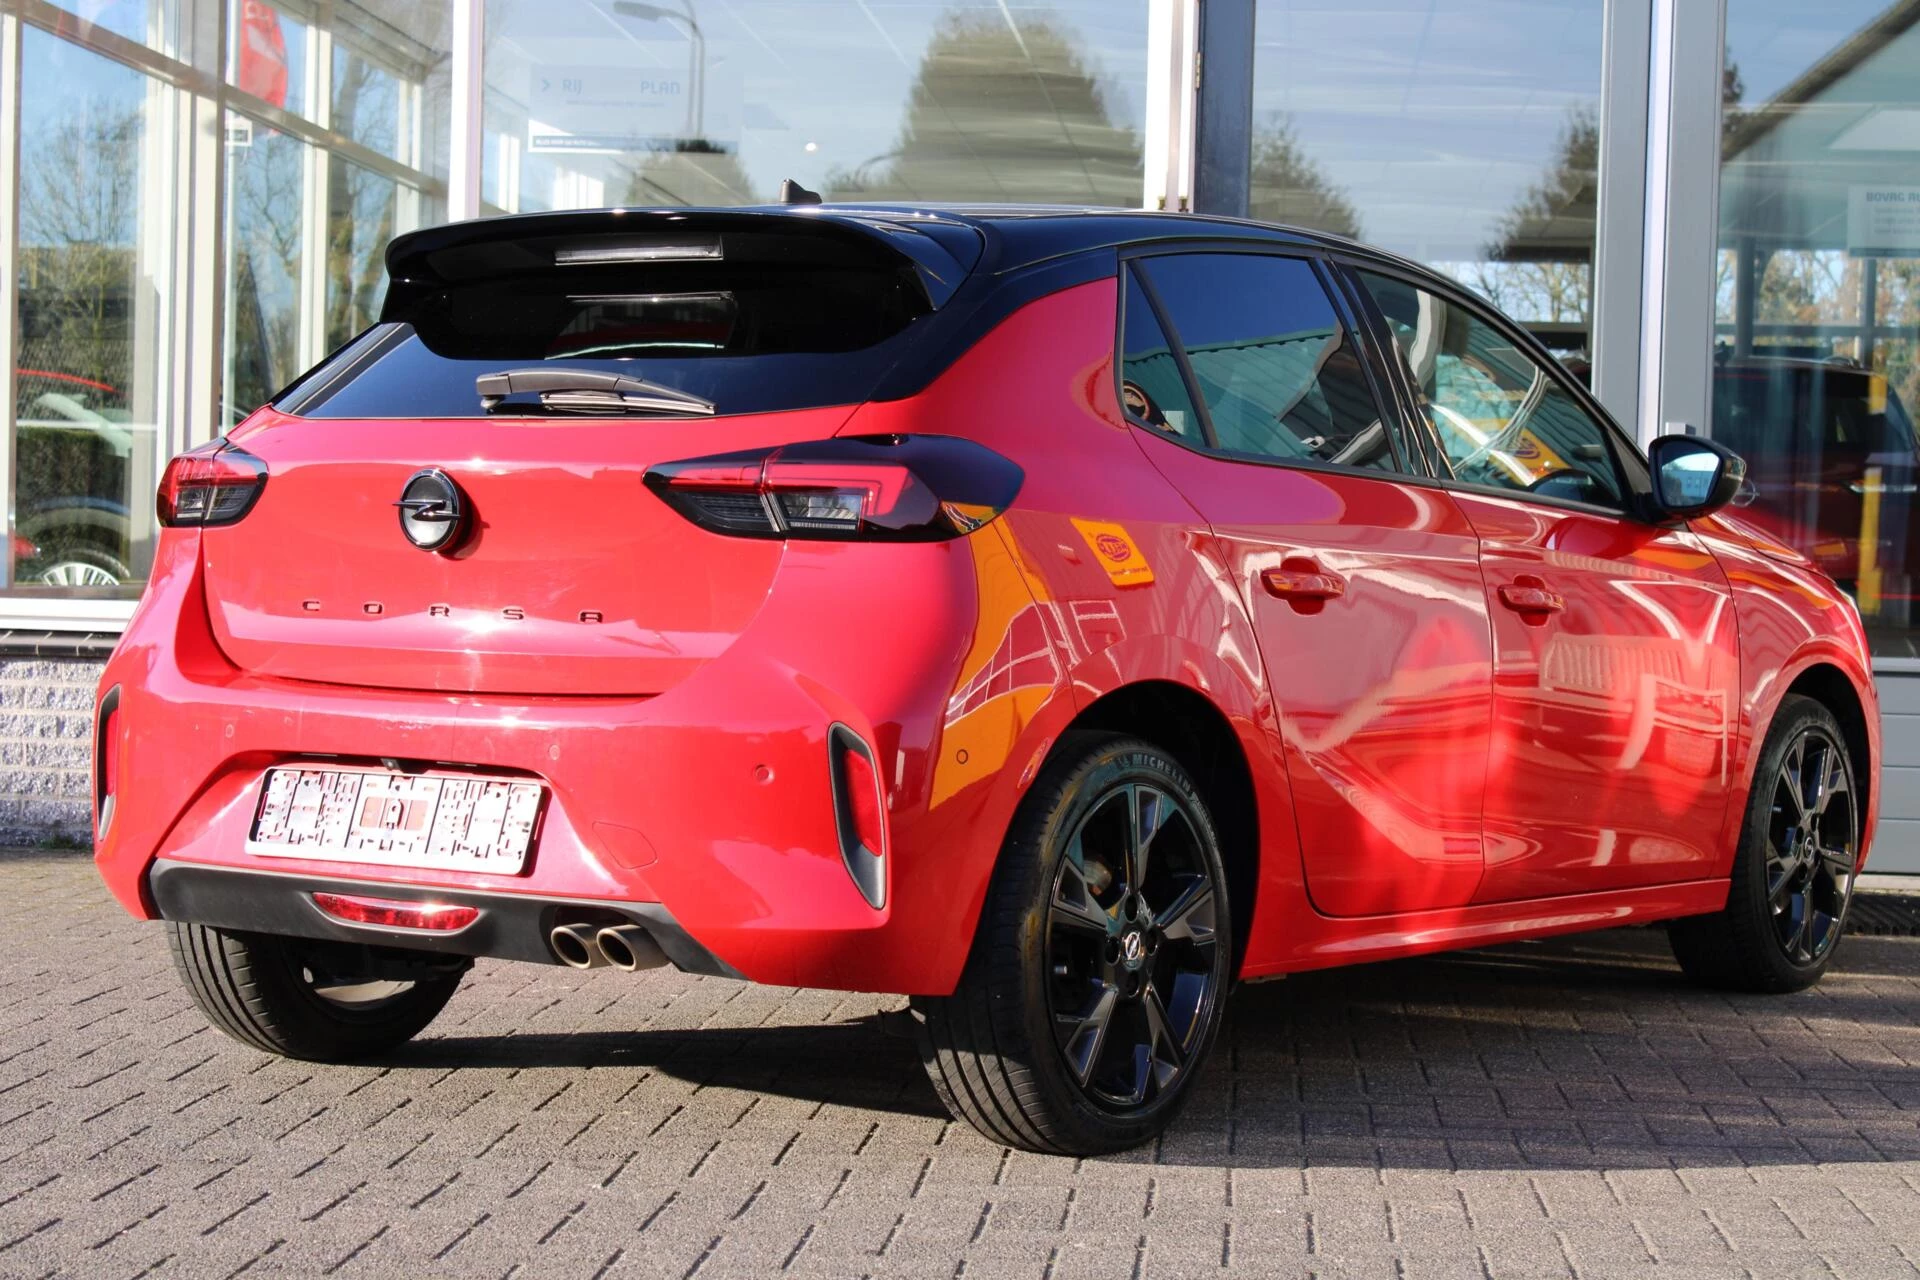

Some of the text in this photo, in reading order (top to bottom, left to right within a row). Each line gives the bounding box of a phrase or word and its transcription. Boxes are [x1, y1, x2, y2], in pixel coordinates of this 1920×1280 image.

[640, 80, 681, 94] PLAN
[302, 600, 604, 624] CORSA
[1132, 753, 1192, 793] MICHELIN
